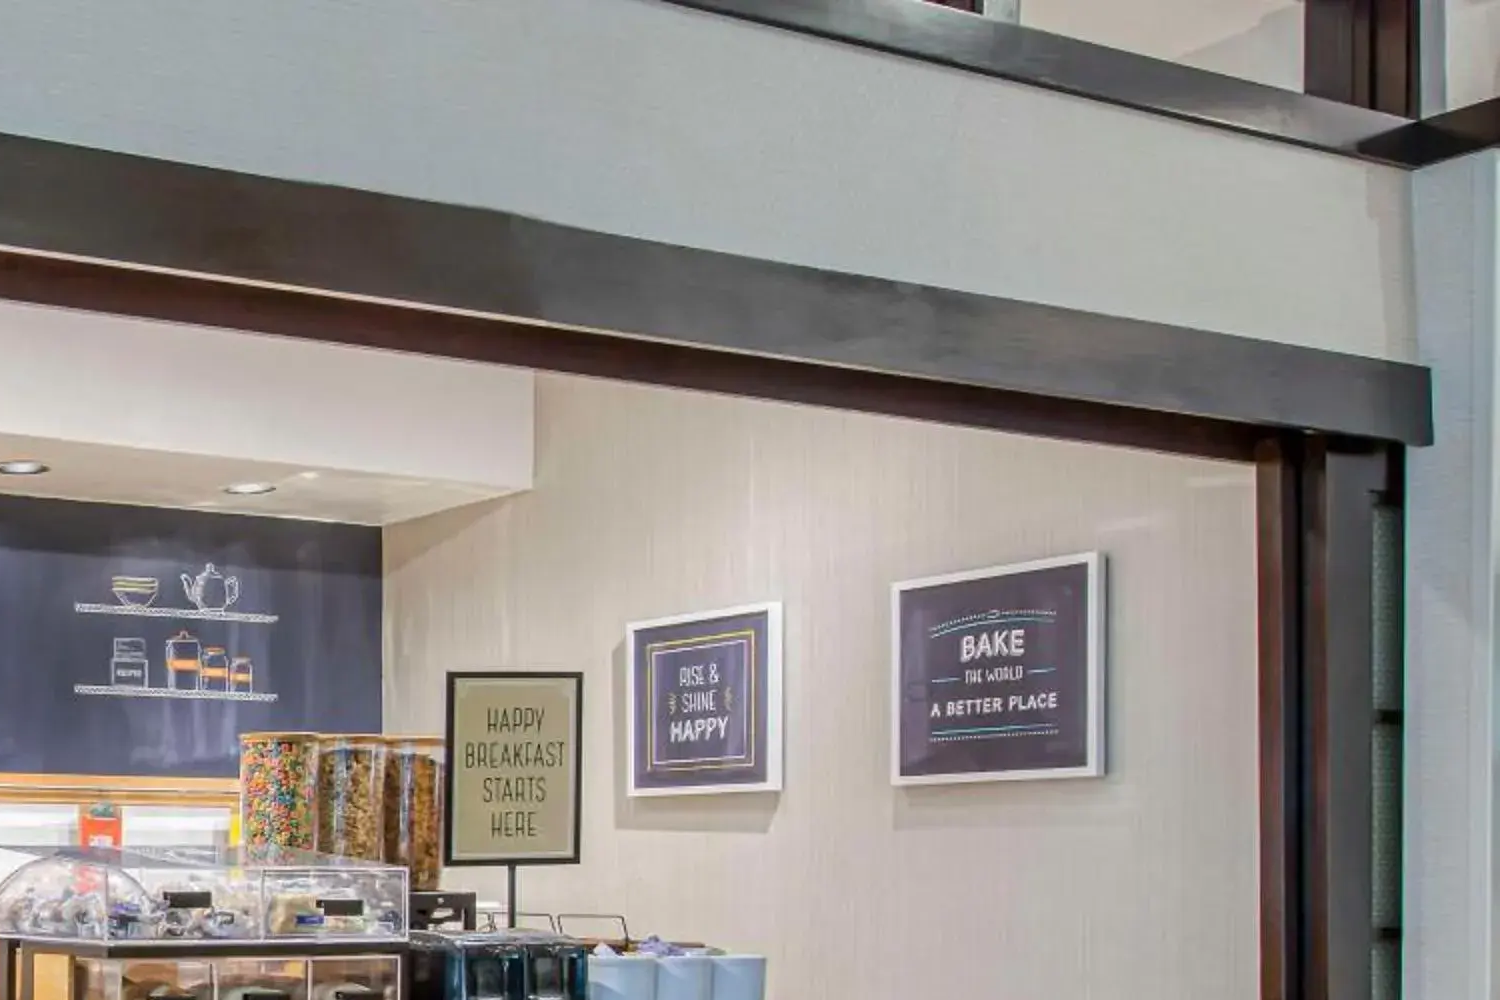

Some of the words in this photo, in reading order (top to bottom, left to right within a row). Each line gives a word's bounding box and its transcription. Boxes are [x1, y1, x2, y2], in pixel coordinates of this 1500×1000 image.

[960, 628, 1025, 662] BAKE
[679, 665, 705, 687] RISE
[709, 663, 719, 684] &
[965, 669, 982, 685] THE
[986, 665, 1024, 683] WORLD
[681, 690, 717, 713] SHINE
[930, 703, 941, 718] A
[946, 697, 1003, 717] BETTER
[1008, 692, 1057, 712] PLACE
[486, 706, 545, 734] HAPPY
[669, 716, 729, 743] HAPPY
[464, 741, 565, 769] BREAKFAST
[482, 776, 547, 803] STARTS
[490, 810, 537, 838] HERE
